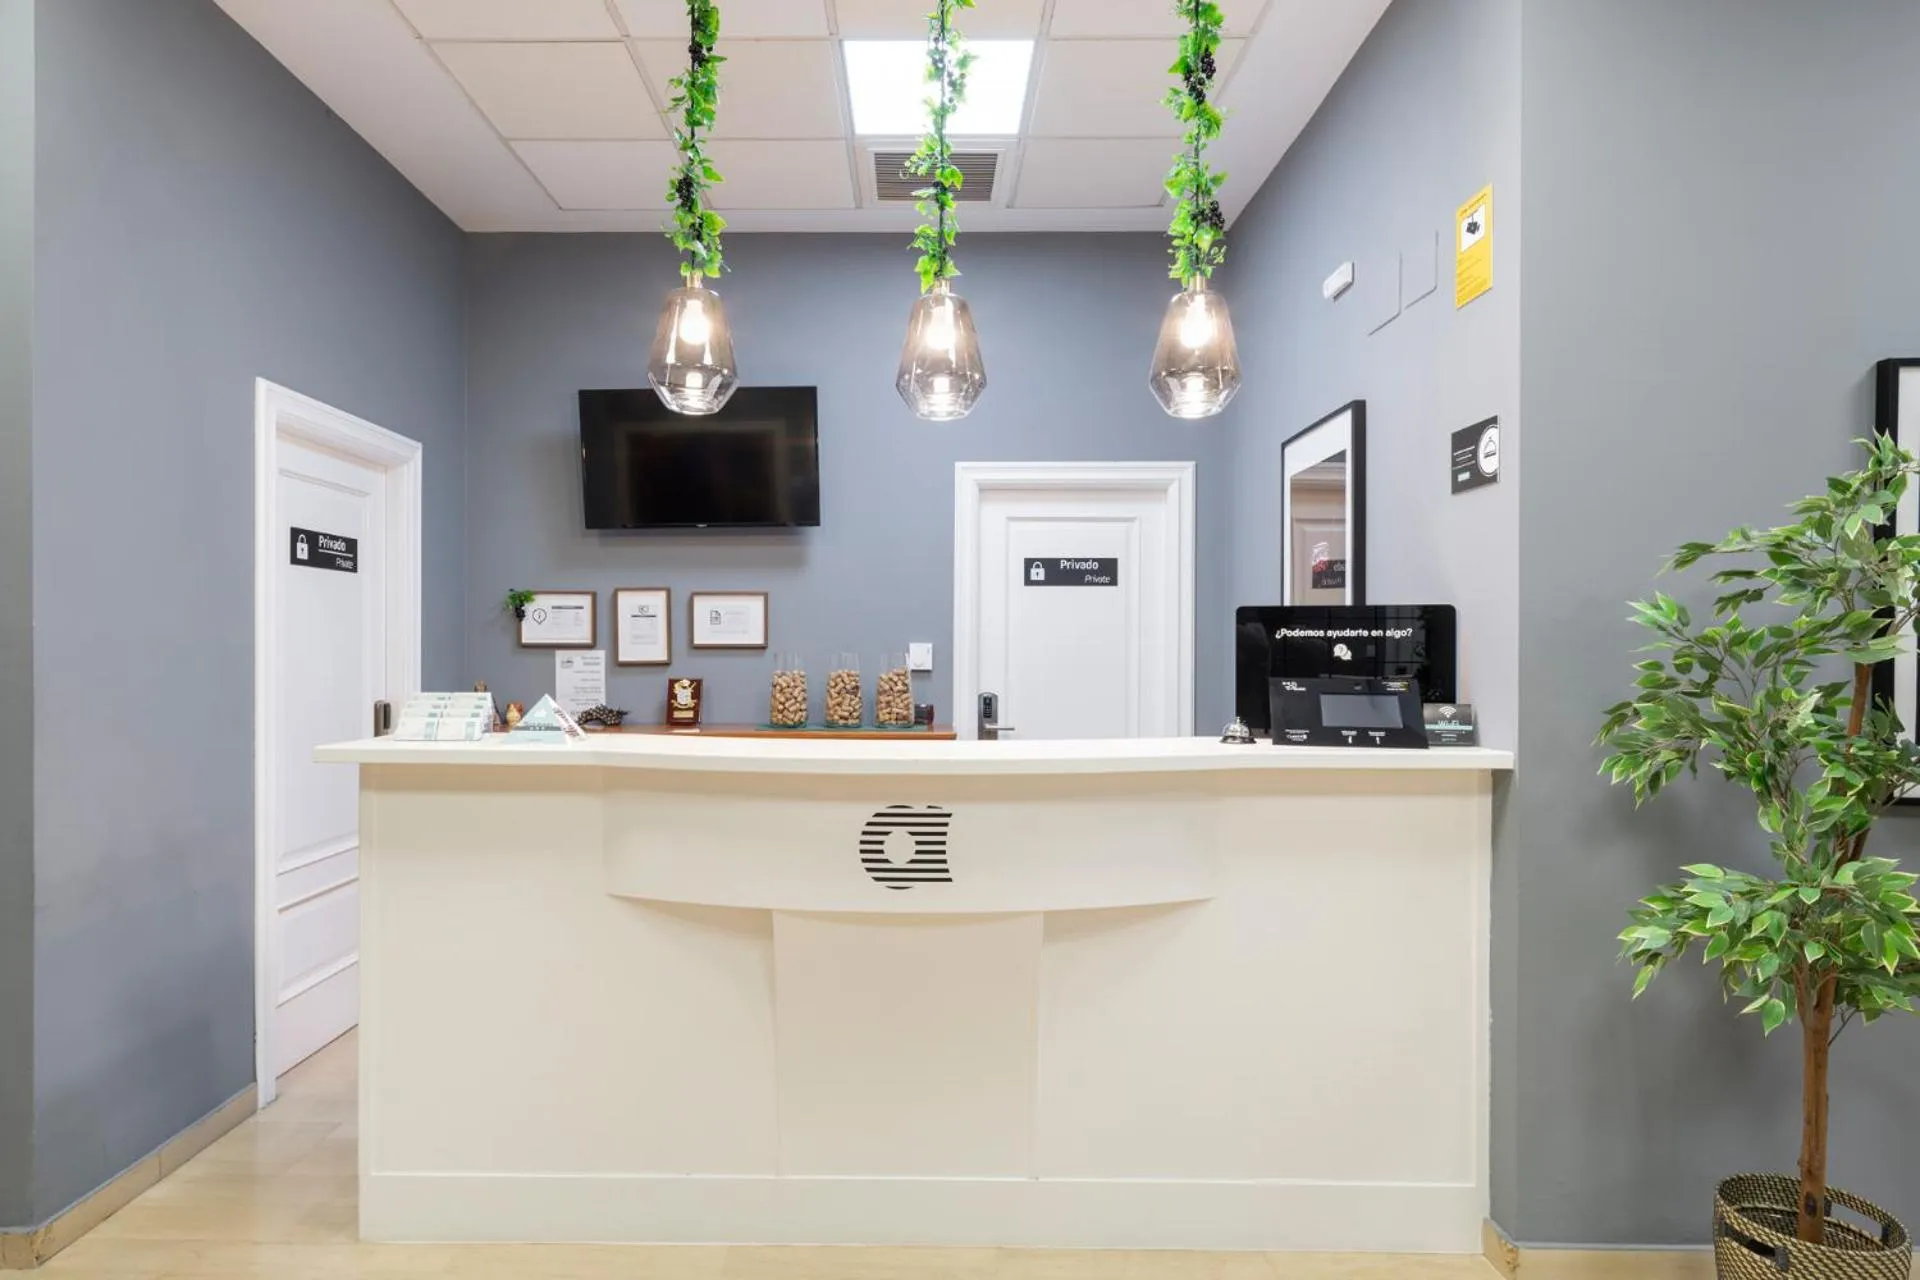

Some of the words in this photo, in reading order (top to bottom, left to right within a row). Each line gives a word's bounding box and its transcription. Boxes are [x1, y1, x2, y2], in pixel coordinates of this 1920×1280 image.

[318, 534, 346, 551] Privado
[1060, 559, 1099, 570] Privado
[1084, 574, 1111, 584] Private
[1276, 628, 1325, 639] ¿Podemos
[1327, 628, 1369, 639] ayudarte
[1371, 629, 1383, 637] en
[1385, 628, 1413, 639] algo?
